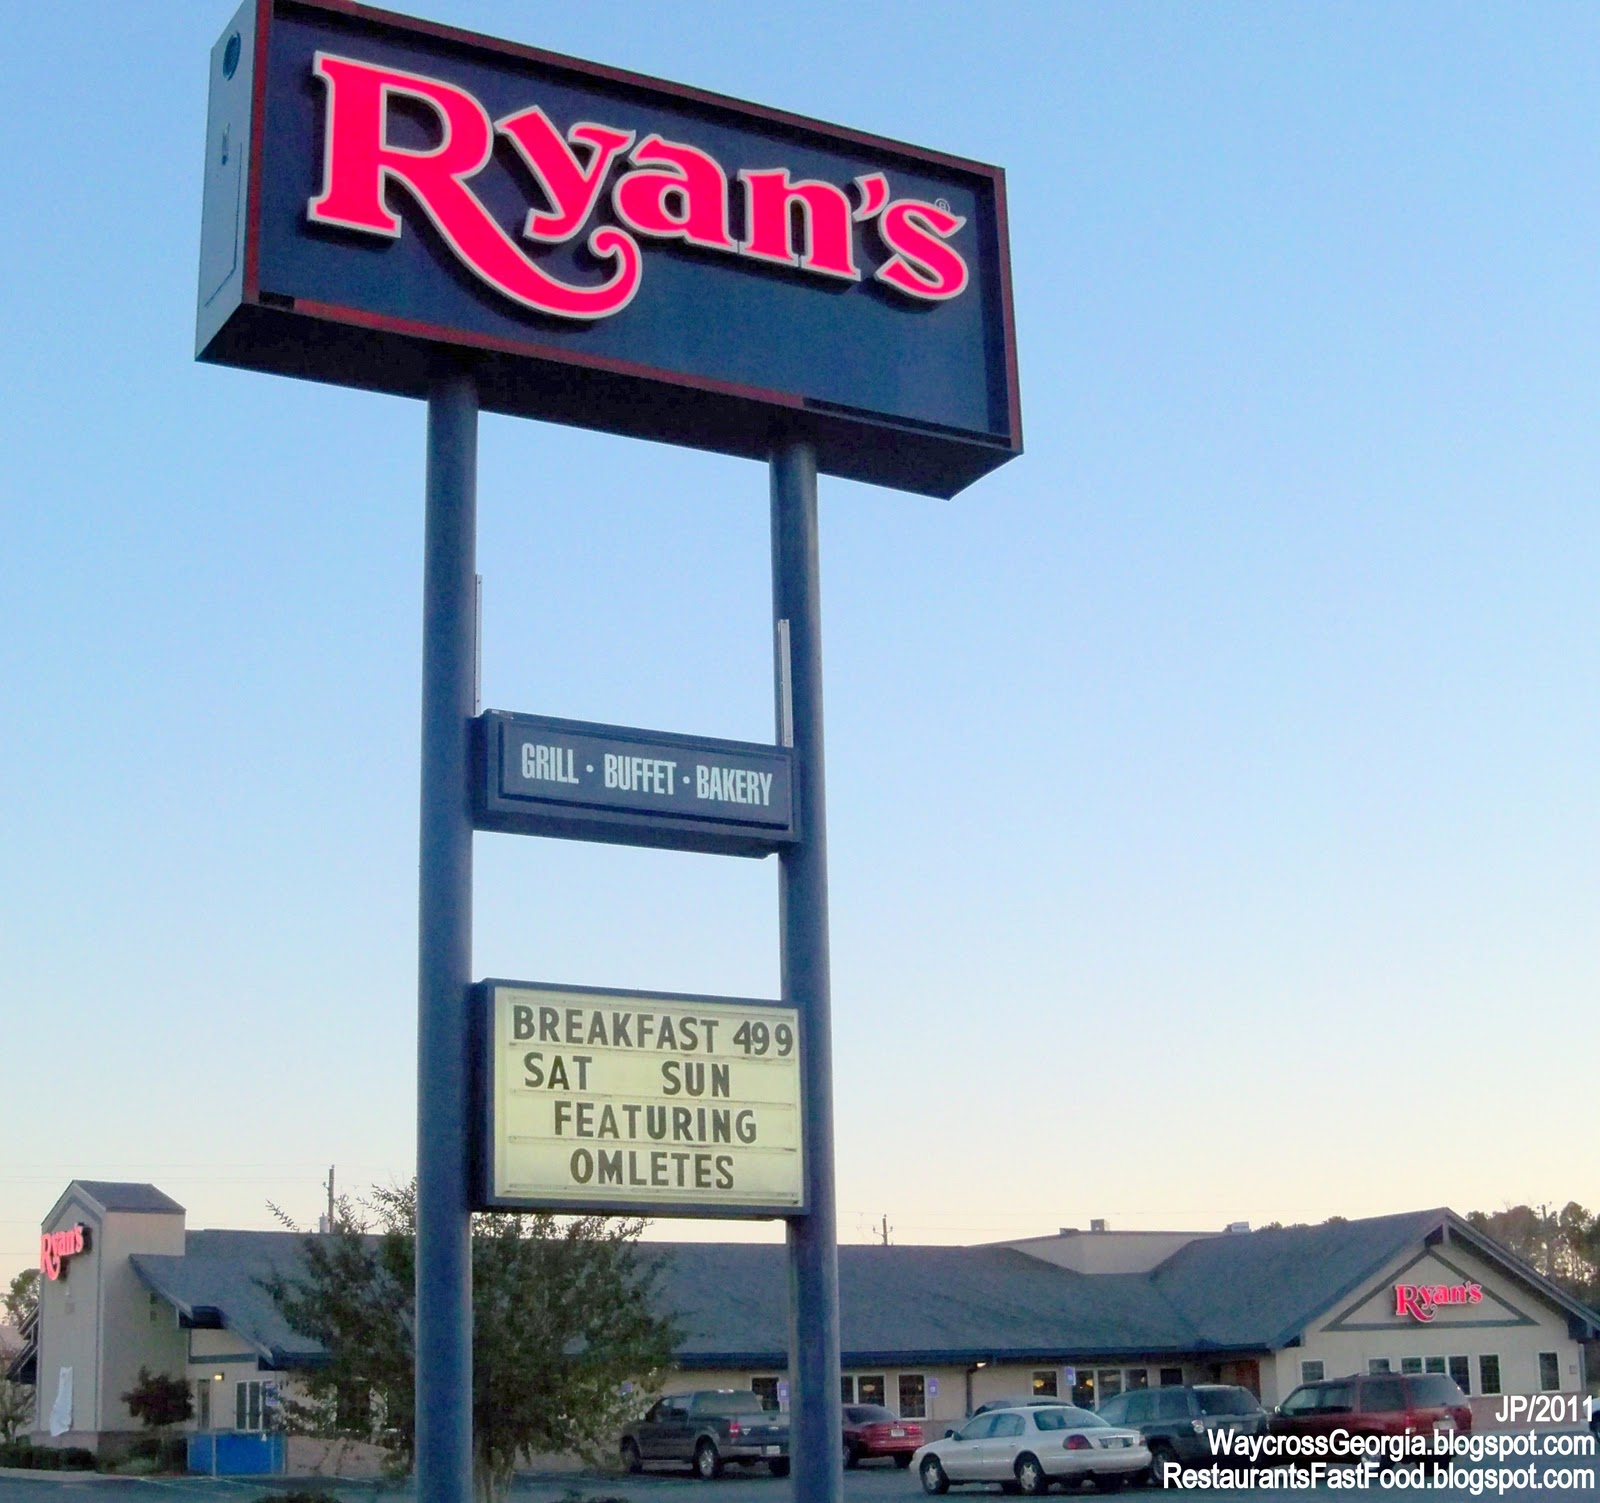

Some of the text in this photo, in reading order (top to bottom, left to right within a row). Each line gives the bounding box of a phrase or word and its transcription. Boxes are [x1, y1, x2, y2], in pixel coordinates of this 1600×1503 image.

[308, 50, 968, 319] Ryan's
[521, 742, 773, 807] GRILL BUFFET BAKERY
[513, 1004, 794, 1057] BREAKFAST 499
[523, 1051, 731, 1098] SAT SUN
[553, 1100, 758, 1145] FEATURING
[570, 1147, 734, 1190] OMLETES
[1395, 1280, 1483, 1322] Ryan's
